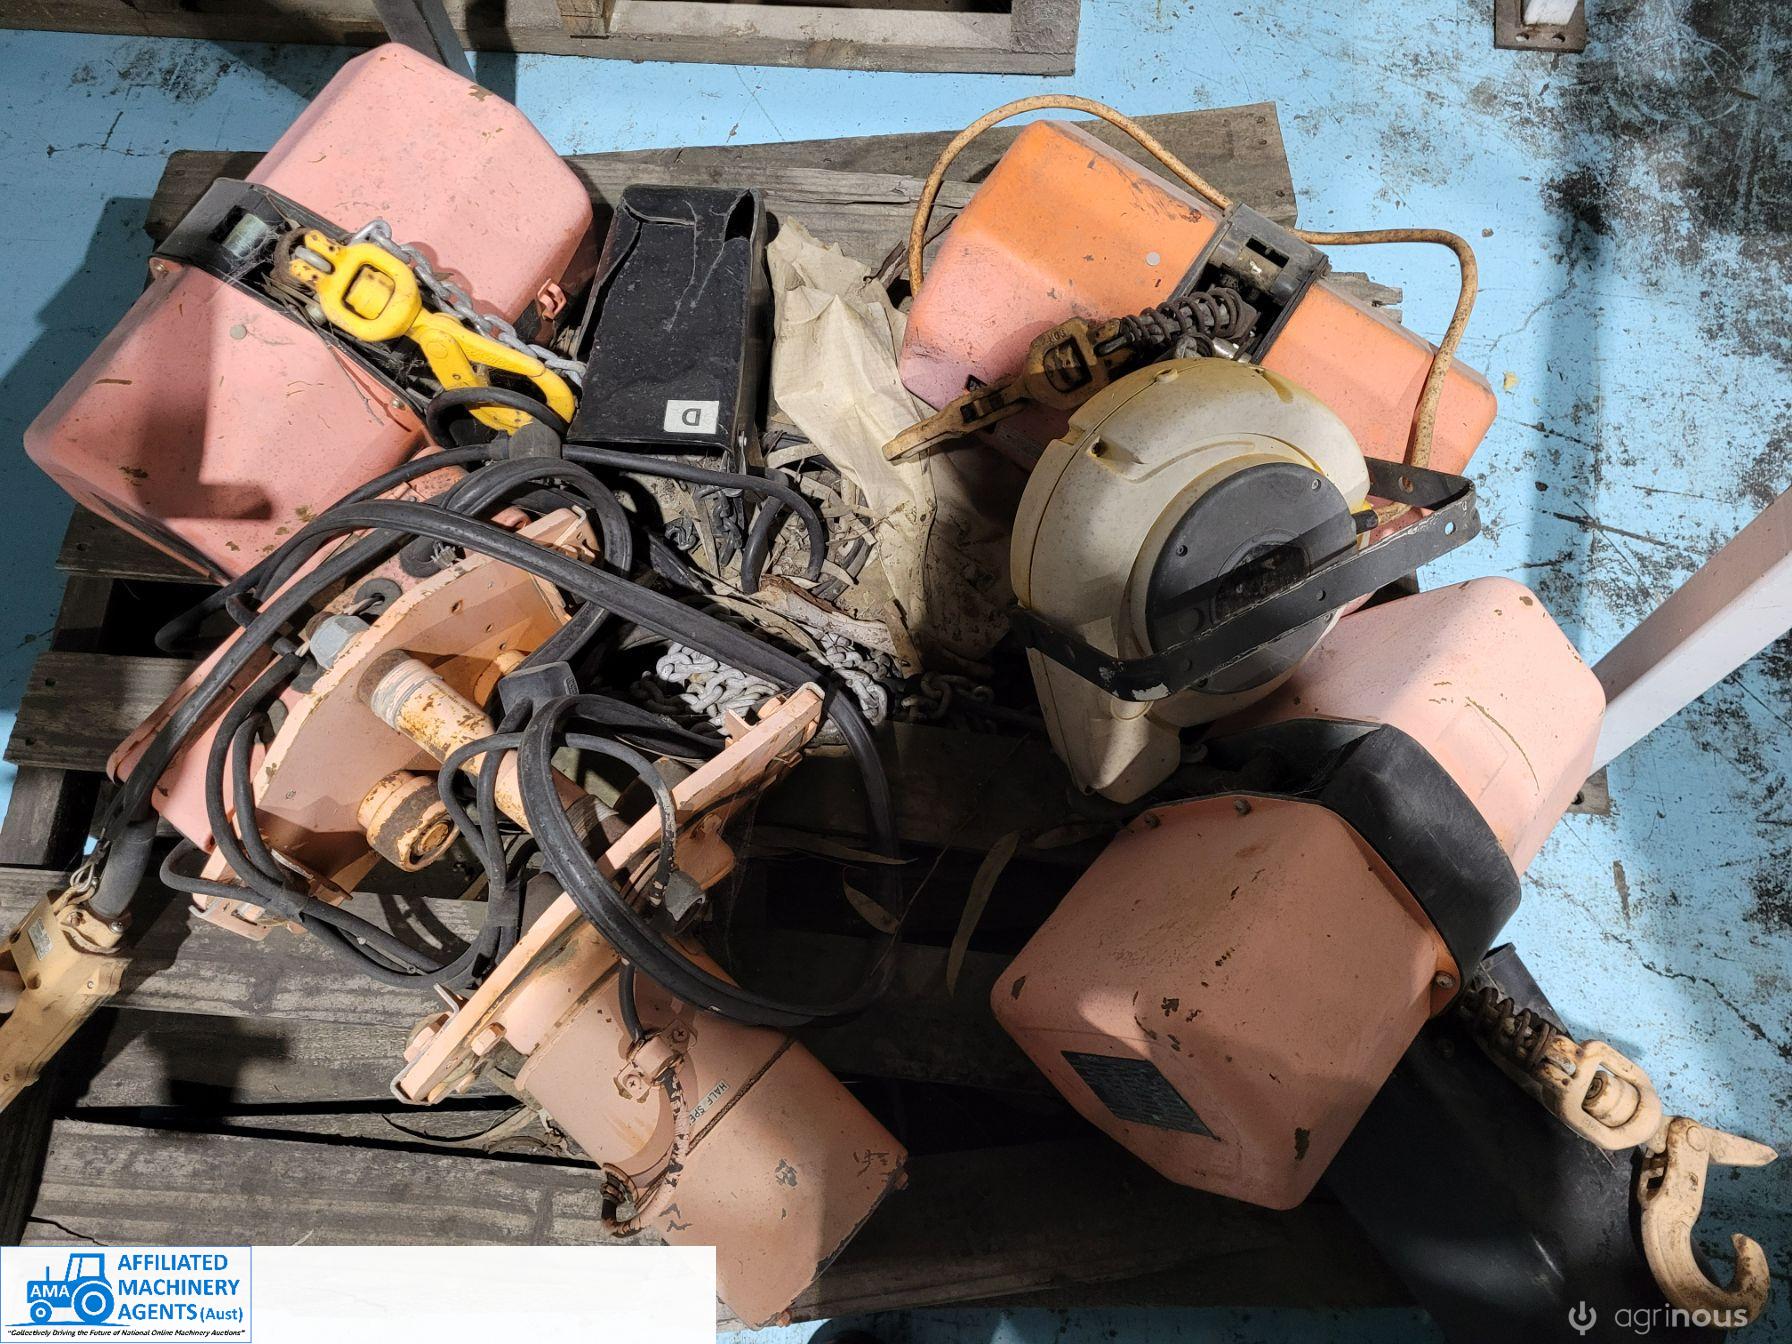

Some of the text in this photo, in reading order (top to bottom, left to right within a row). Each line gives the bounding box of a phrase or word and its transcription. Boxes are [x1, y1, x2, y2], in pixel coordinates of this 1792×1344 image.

[681, 408, 701, 427] D
[689, 1082, 728, 1126] HALF SPE
